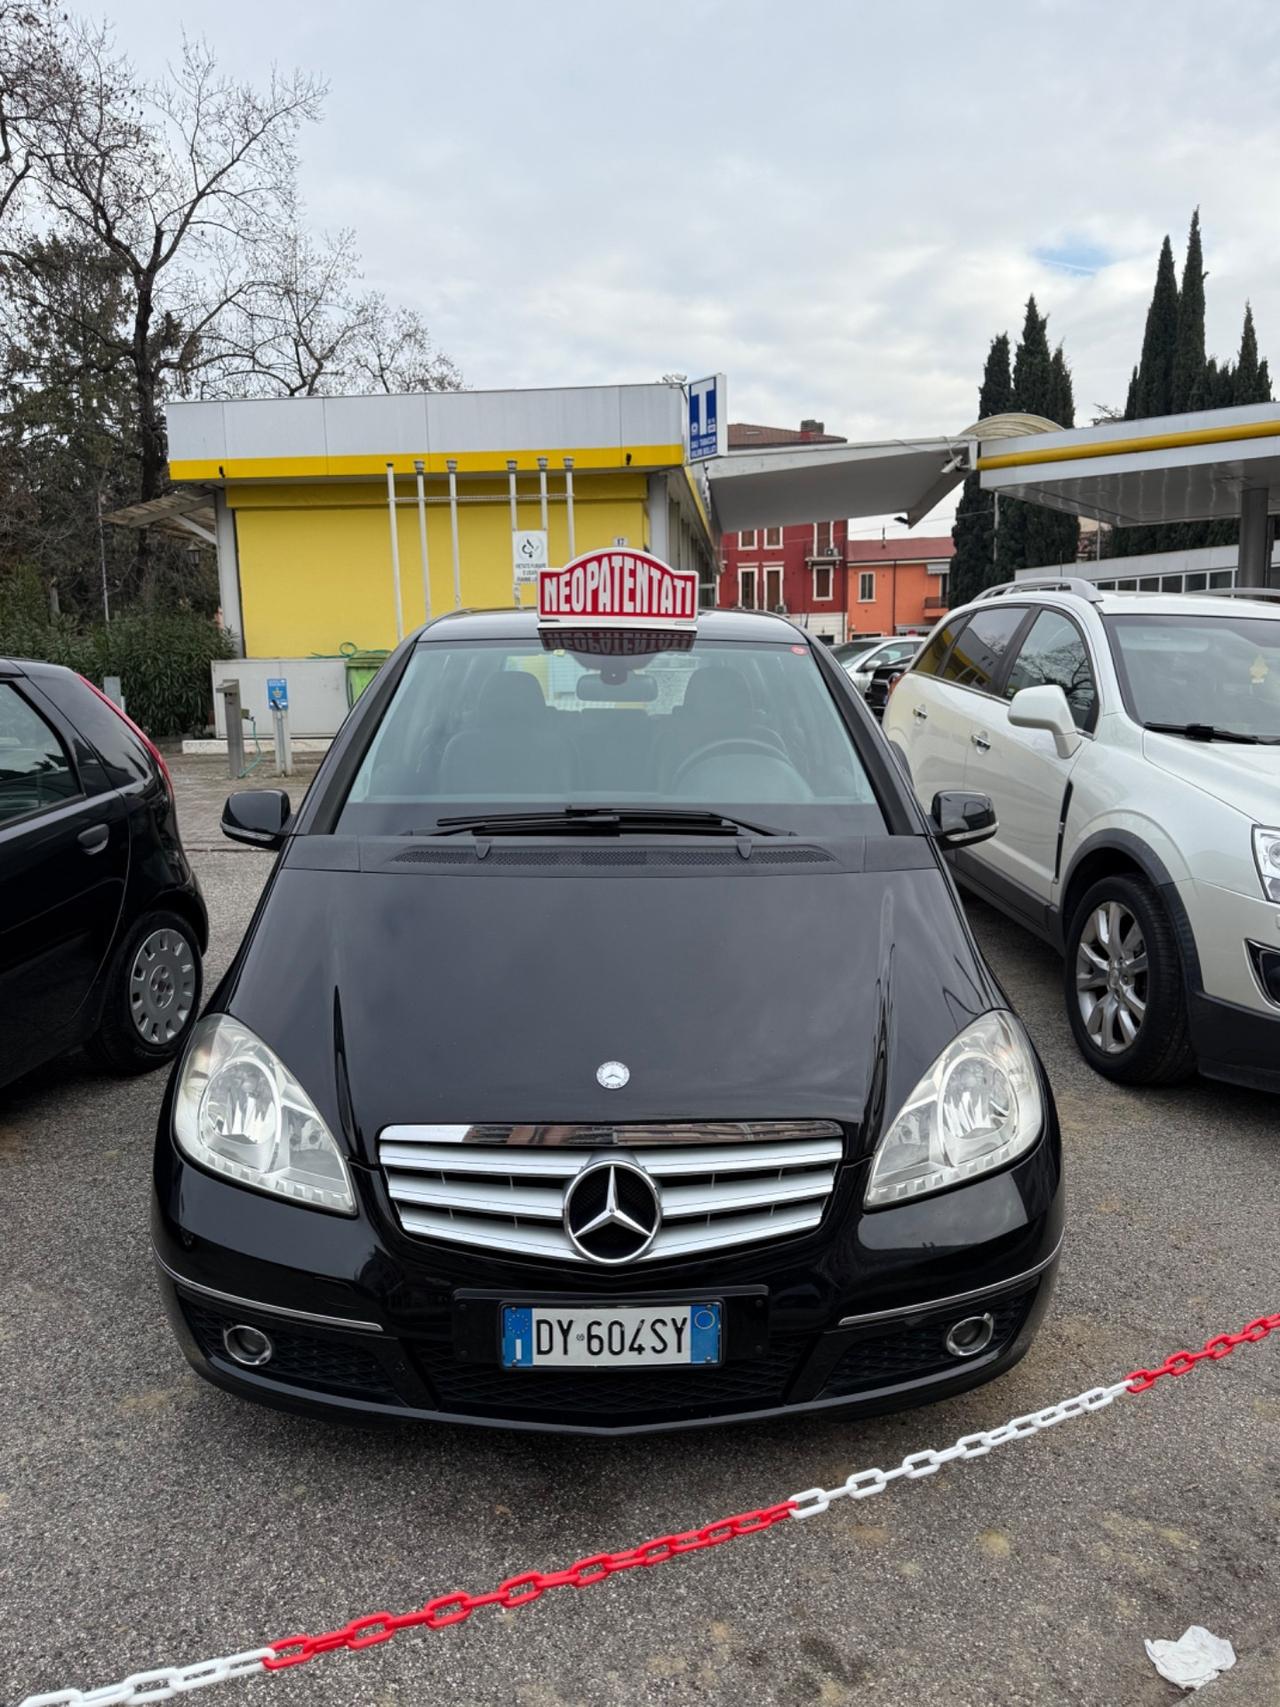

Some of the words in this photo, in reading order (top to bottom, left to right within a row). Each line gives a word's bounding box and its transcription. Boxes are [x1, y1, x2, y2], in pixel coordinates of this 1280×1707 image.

[691, 378, 714, 436] T
[544, 556, 692, 615] NEOPATENTATI
[515, 1339, 522, 1360] I
